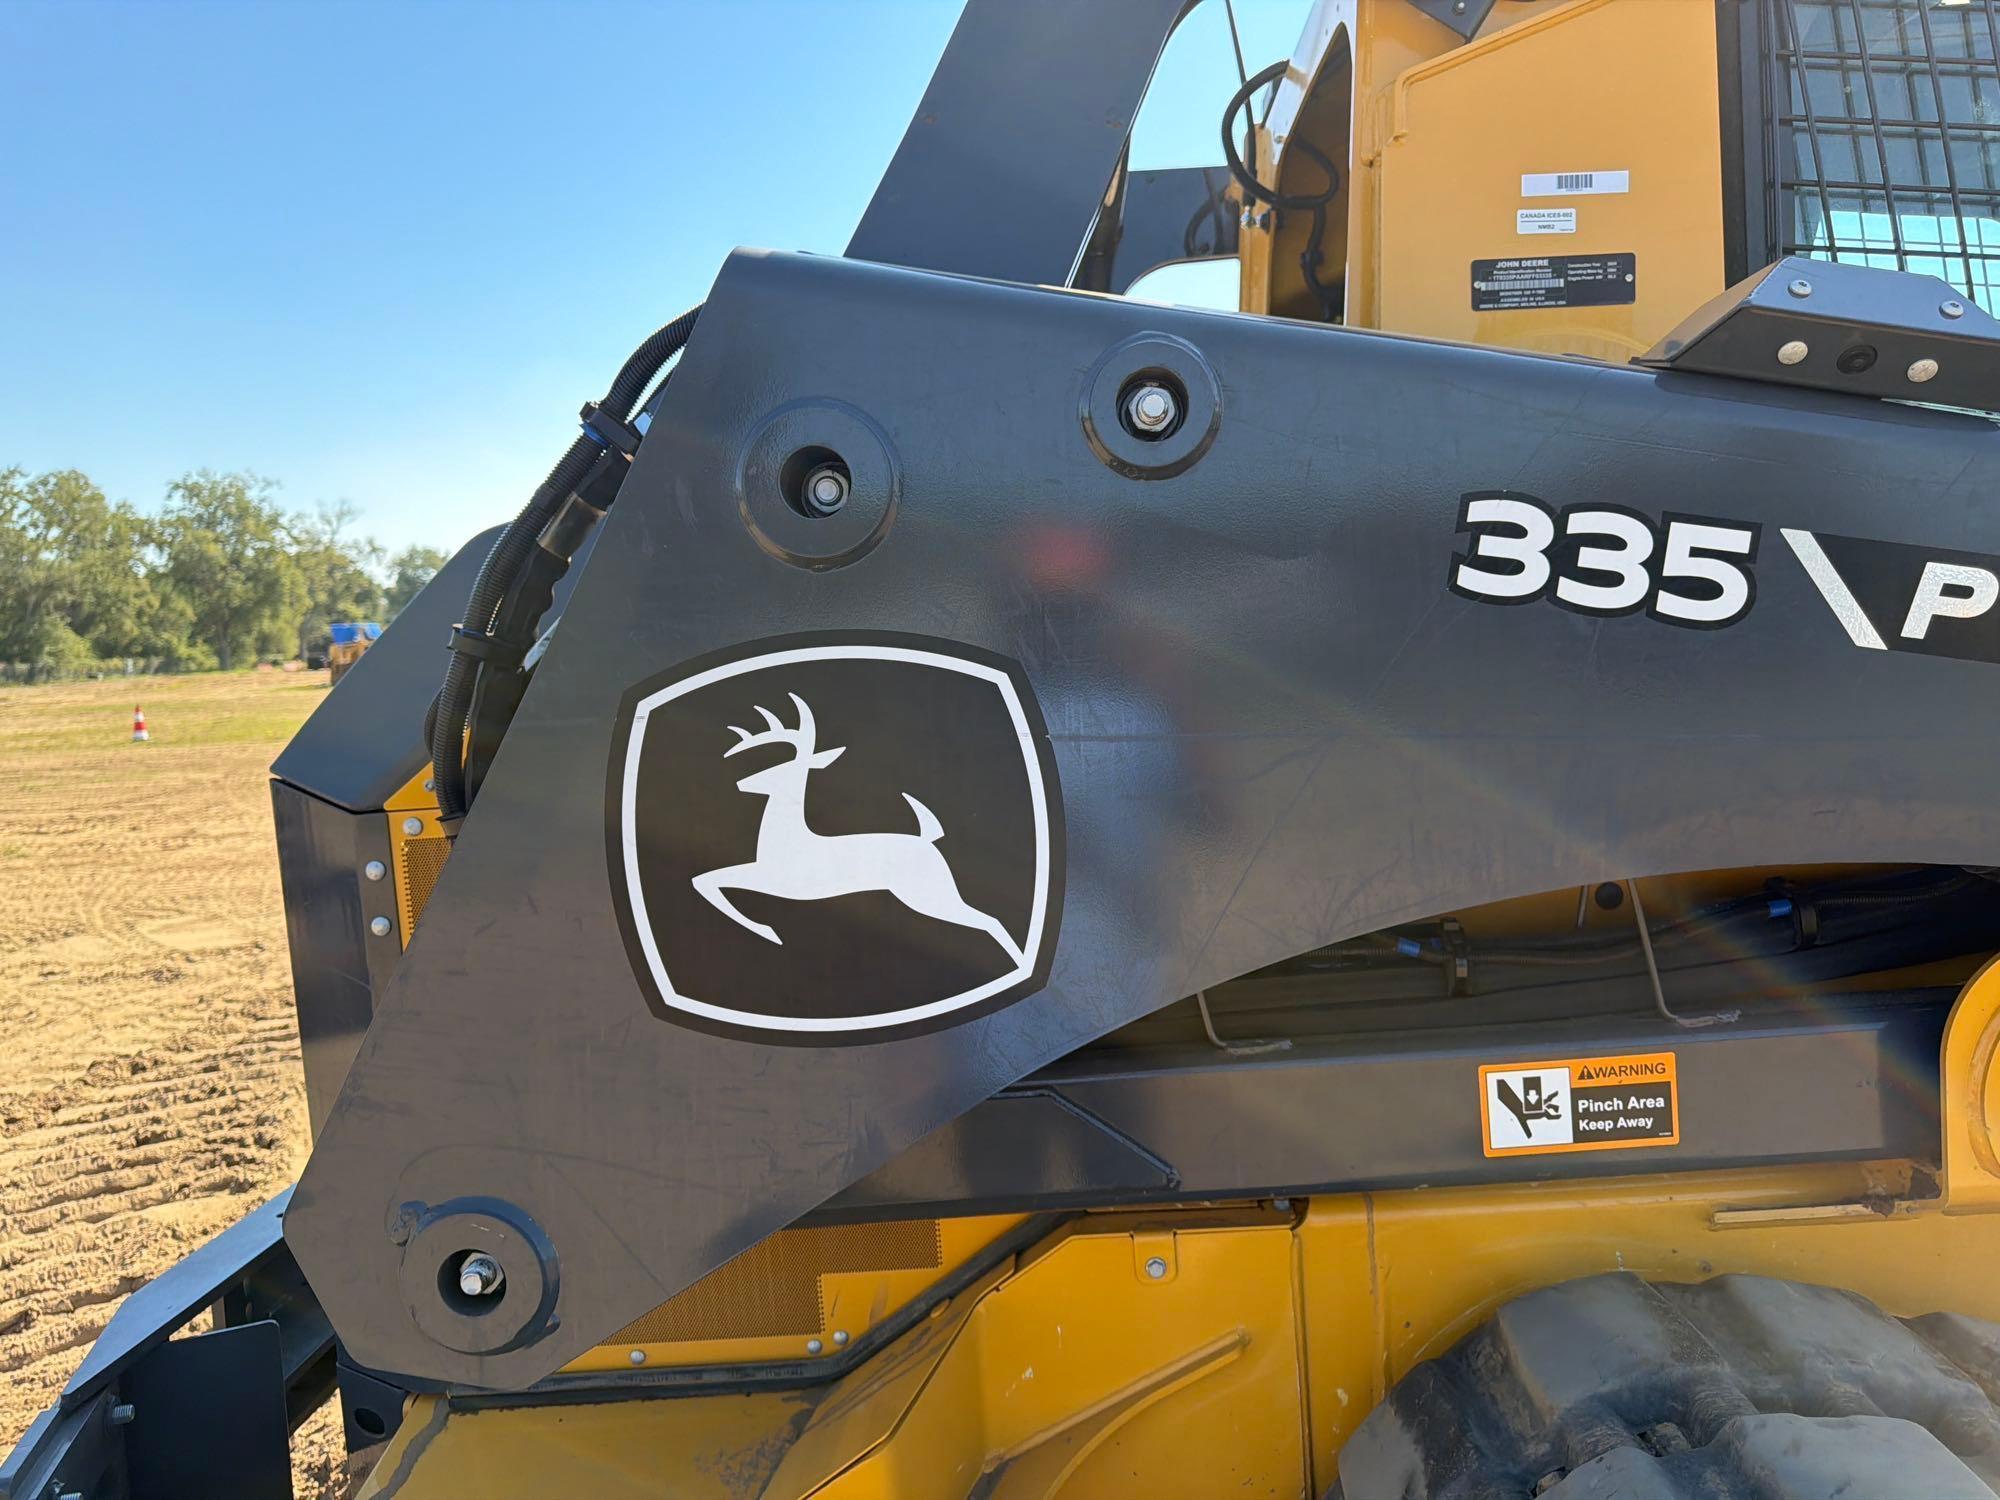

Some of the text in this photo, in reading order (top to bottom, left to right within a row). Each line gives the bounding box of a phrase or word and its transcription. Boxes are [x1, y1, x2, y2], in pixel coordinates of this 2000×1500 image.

[1496, 259, 1549, 269] JOHN DEERE
[1456, 499, 1753, 621] 335
[1594, 1062, 1666, 1078] WARNING
[1578, 1095, 1665, 1113] Pinch Area
[1579, 1116, 1653, 1132] Keep Away
